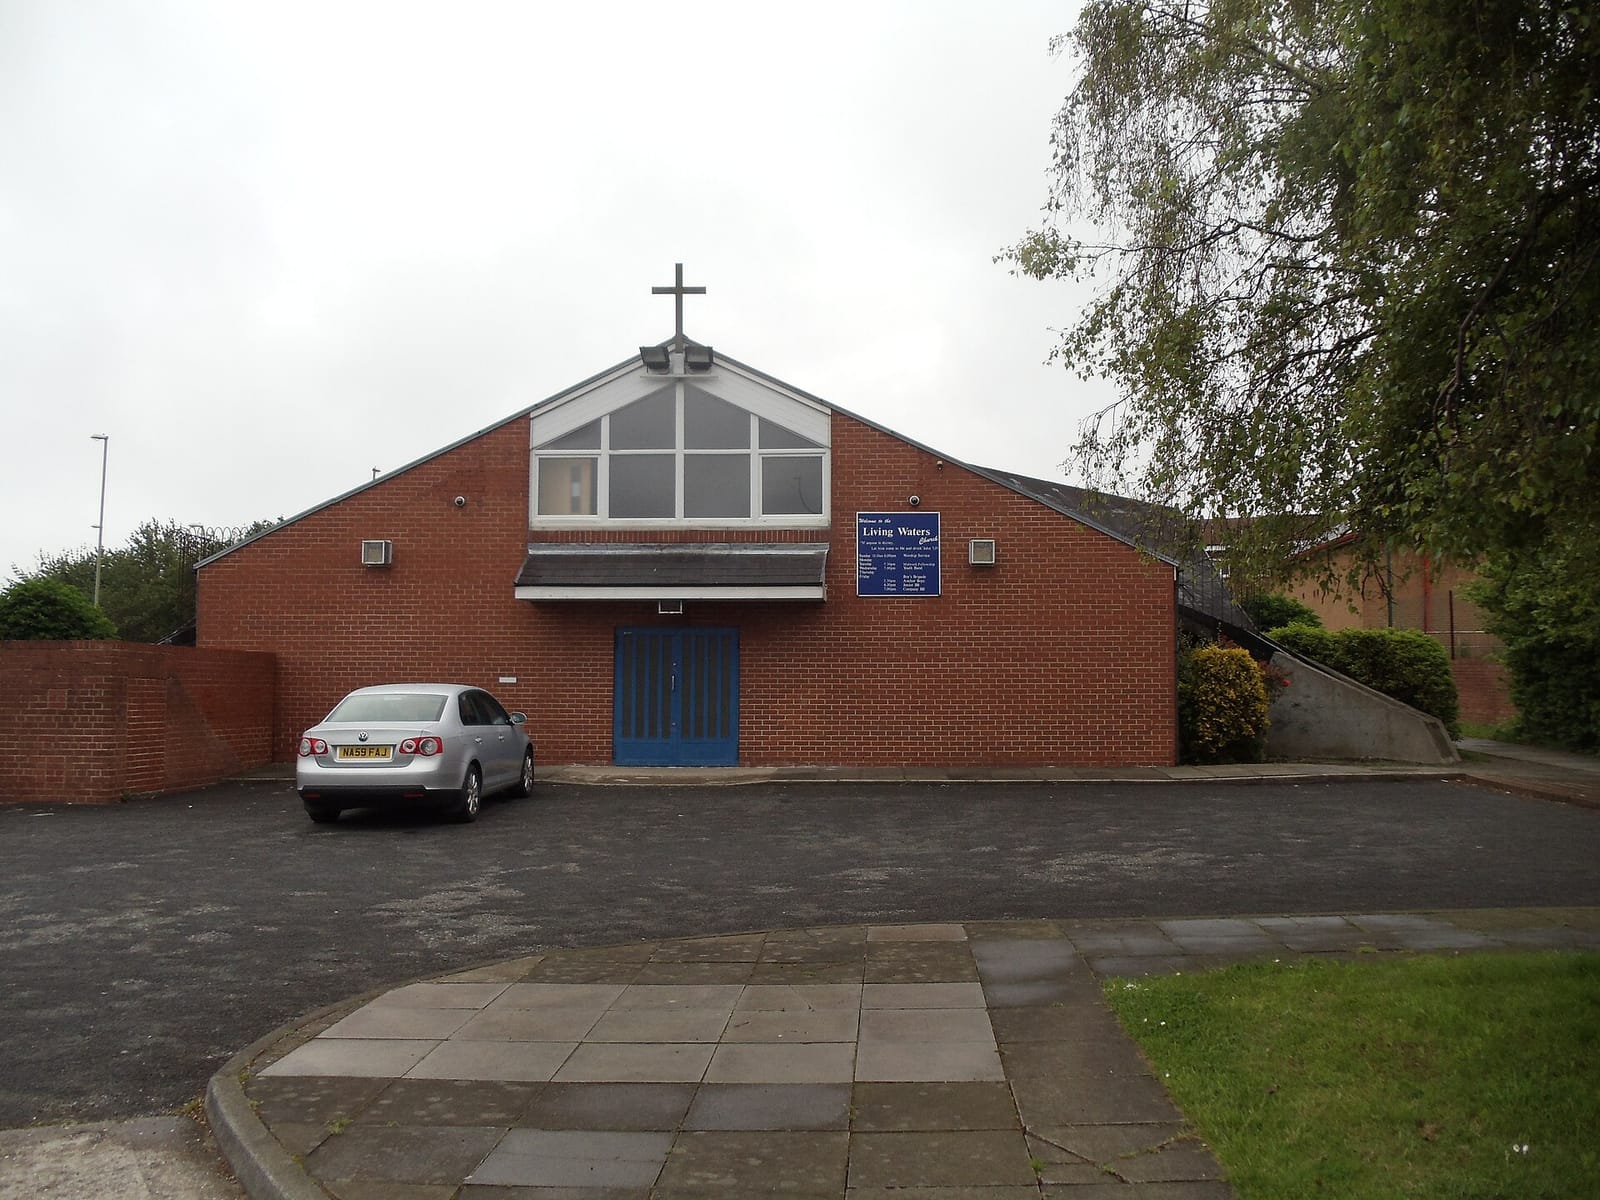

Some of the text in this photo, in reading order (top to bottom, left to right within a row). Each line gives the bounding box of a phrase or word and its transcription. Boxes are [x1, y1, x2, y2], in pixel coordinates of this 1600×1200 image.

[863, 527, 931, 538] Living Waters
[343, 747, 387, 757] NA59 FAJ
